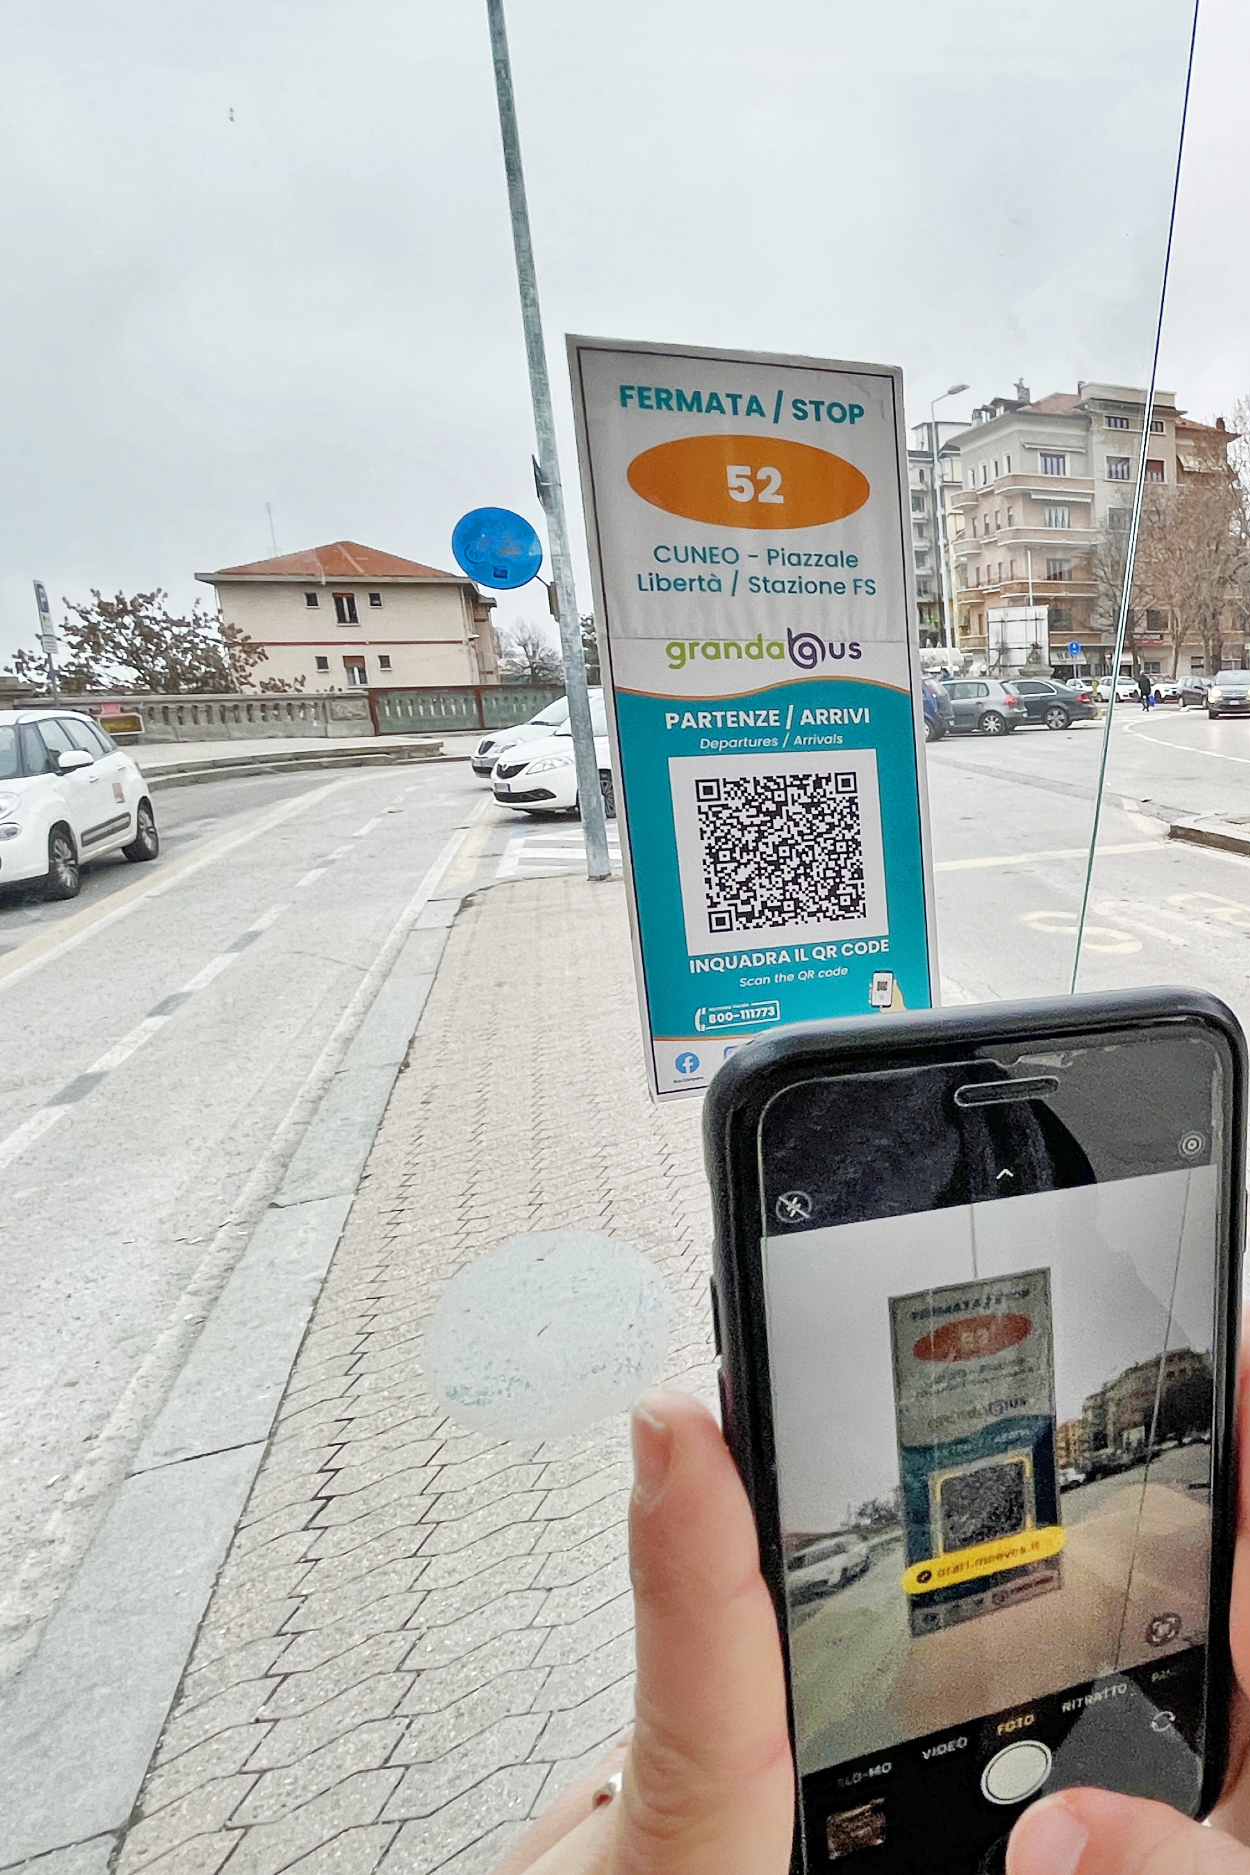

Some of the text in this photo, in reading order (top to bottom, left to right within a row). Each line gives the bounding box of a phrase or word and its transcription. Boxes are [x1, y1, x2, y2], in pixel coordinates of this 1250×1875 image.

[619, 384, 865, 425] FERMATA / STOP
[726, 465, 785, 504] 52
[653, 546, 740, 564] CUNEO
[767, 548, 859, 568] Piazzale
[637, 570, 876, 596] Libertà / Stazione FS
[664, 704, 870, 730] PARTENZE / ARRIVI
[699, 733, 843, 751] Departures / Arrivals
[689, 938, 890, 974] INQUADRA IL QR CODE
[739, 965, 848, 988] Scan the QR code
[708, 1006, 775, 1024] 800-111773
[922, 1736, 968, 1760] VIDEO
[997, 1714, 1035, 1736] FOTO
[1062, 1683, 1127, 1713] RITRATTO
